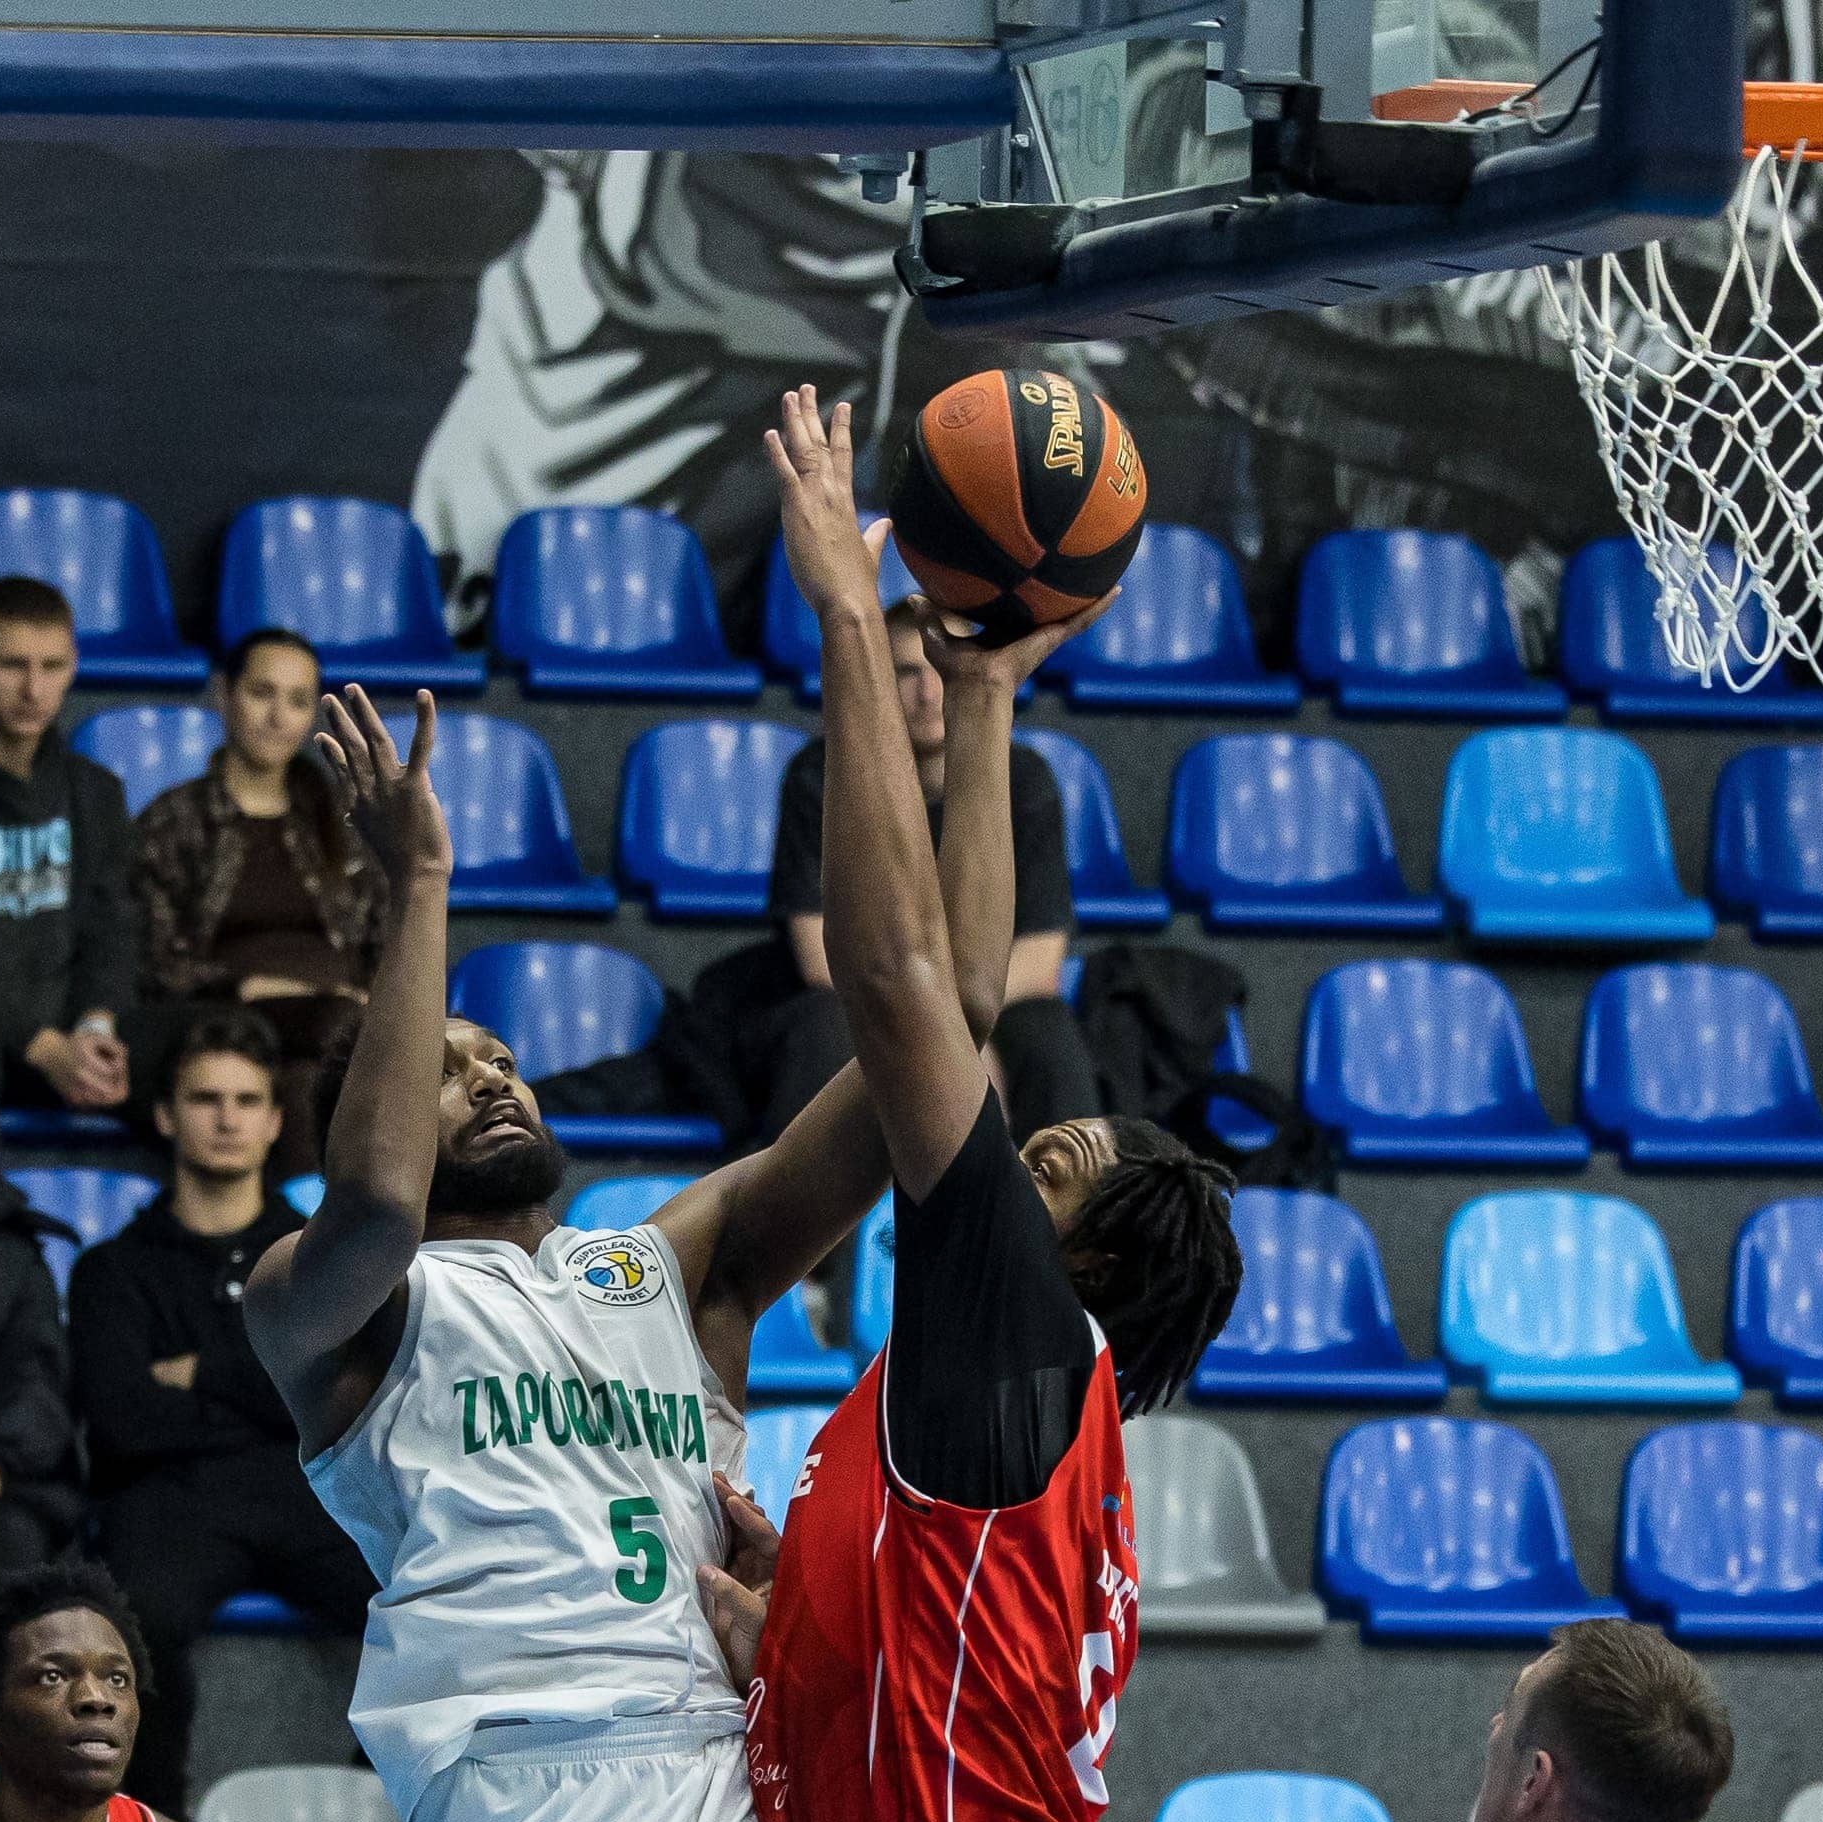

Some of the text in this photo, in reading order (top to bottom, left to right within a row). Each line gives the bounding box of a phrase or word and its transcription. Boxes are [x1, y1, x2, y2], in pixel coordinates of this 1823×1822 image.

[1039, 370, 1083, 477] SPALD
[573, 1240, 648, 1267] SUPERLEAGUE
[602, 1286, 651, 1302] FAVBET
[609, 1496, 667, 1604] 5
